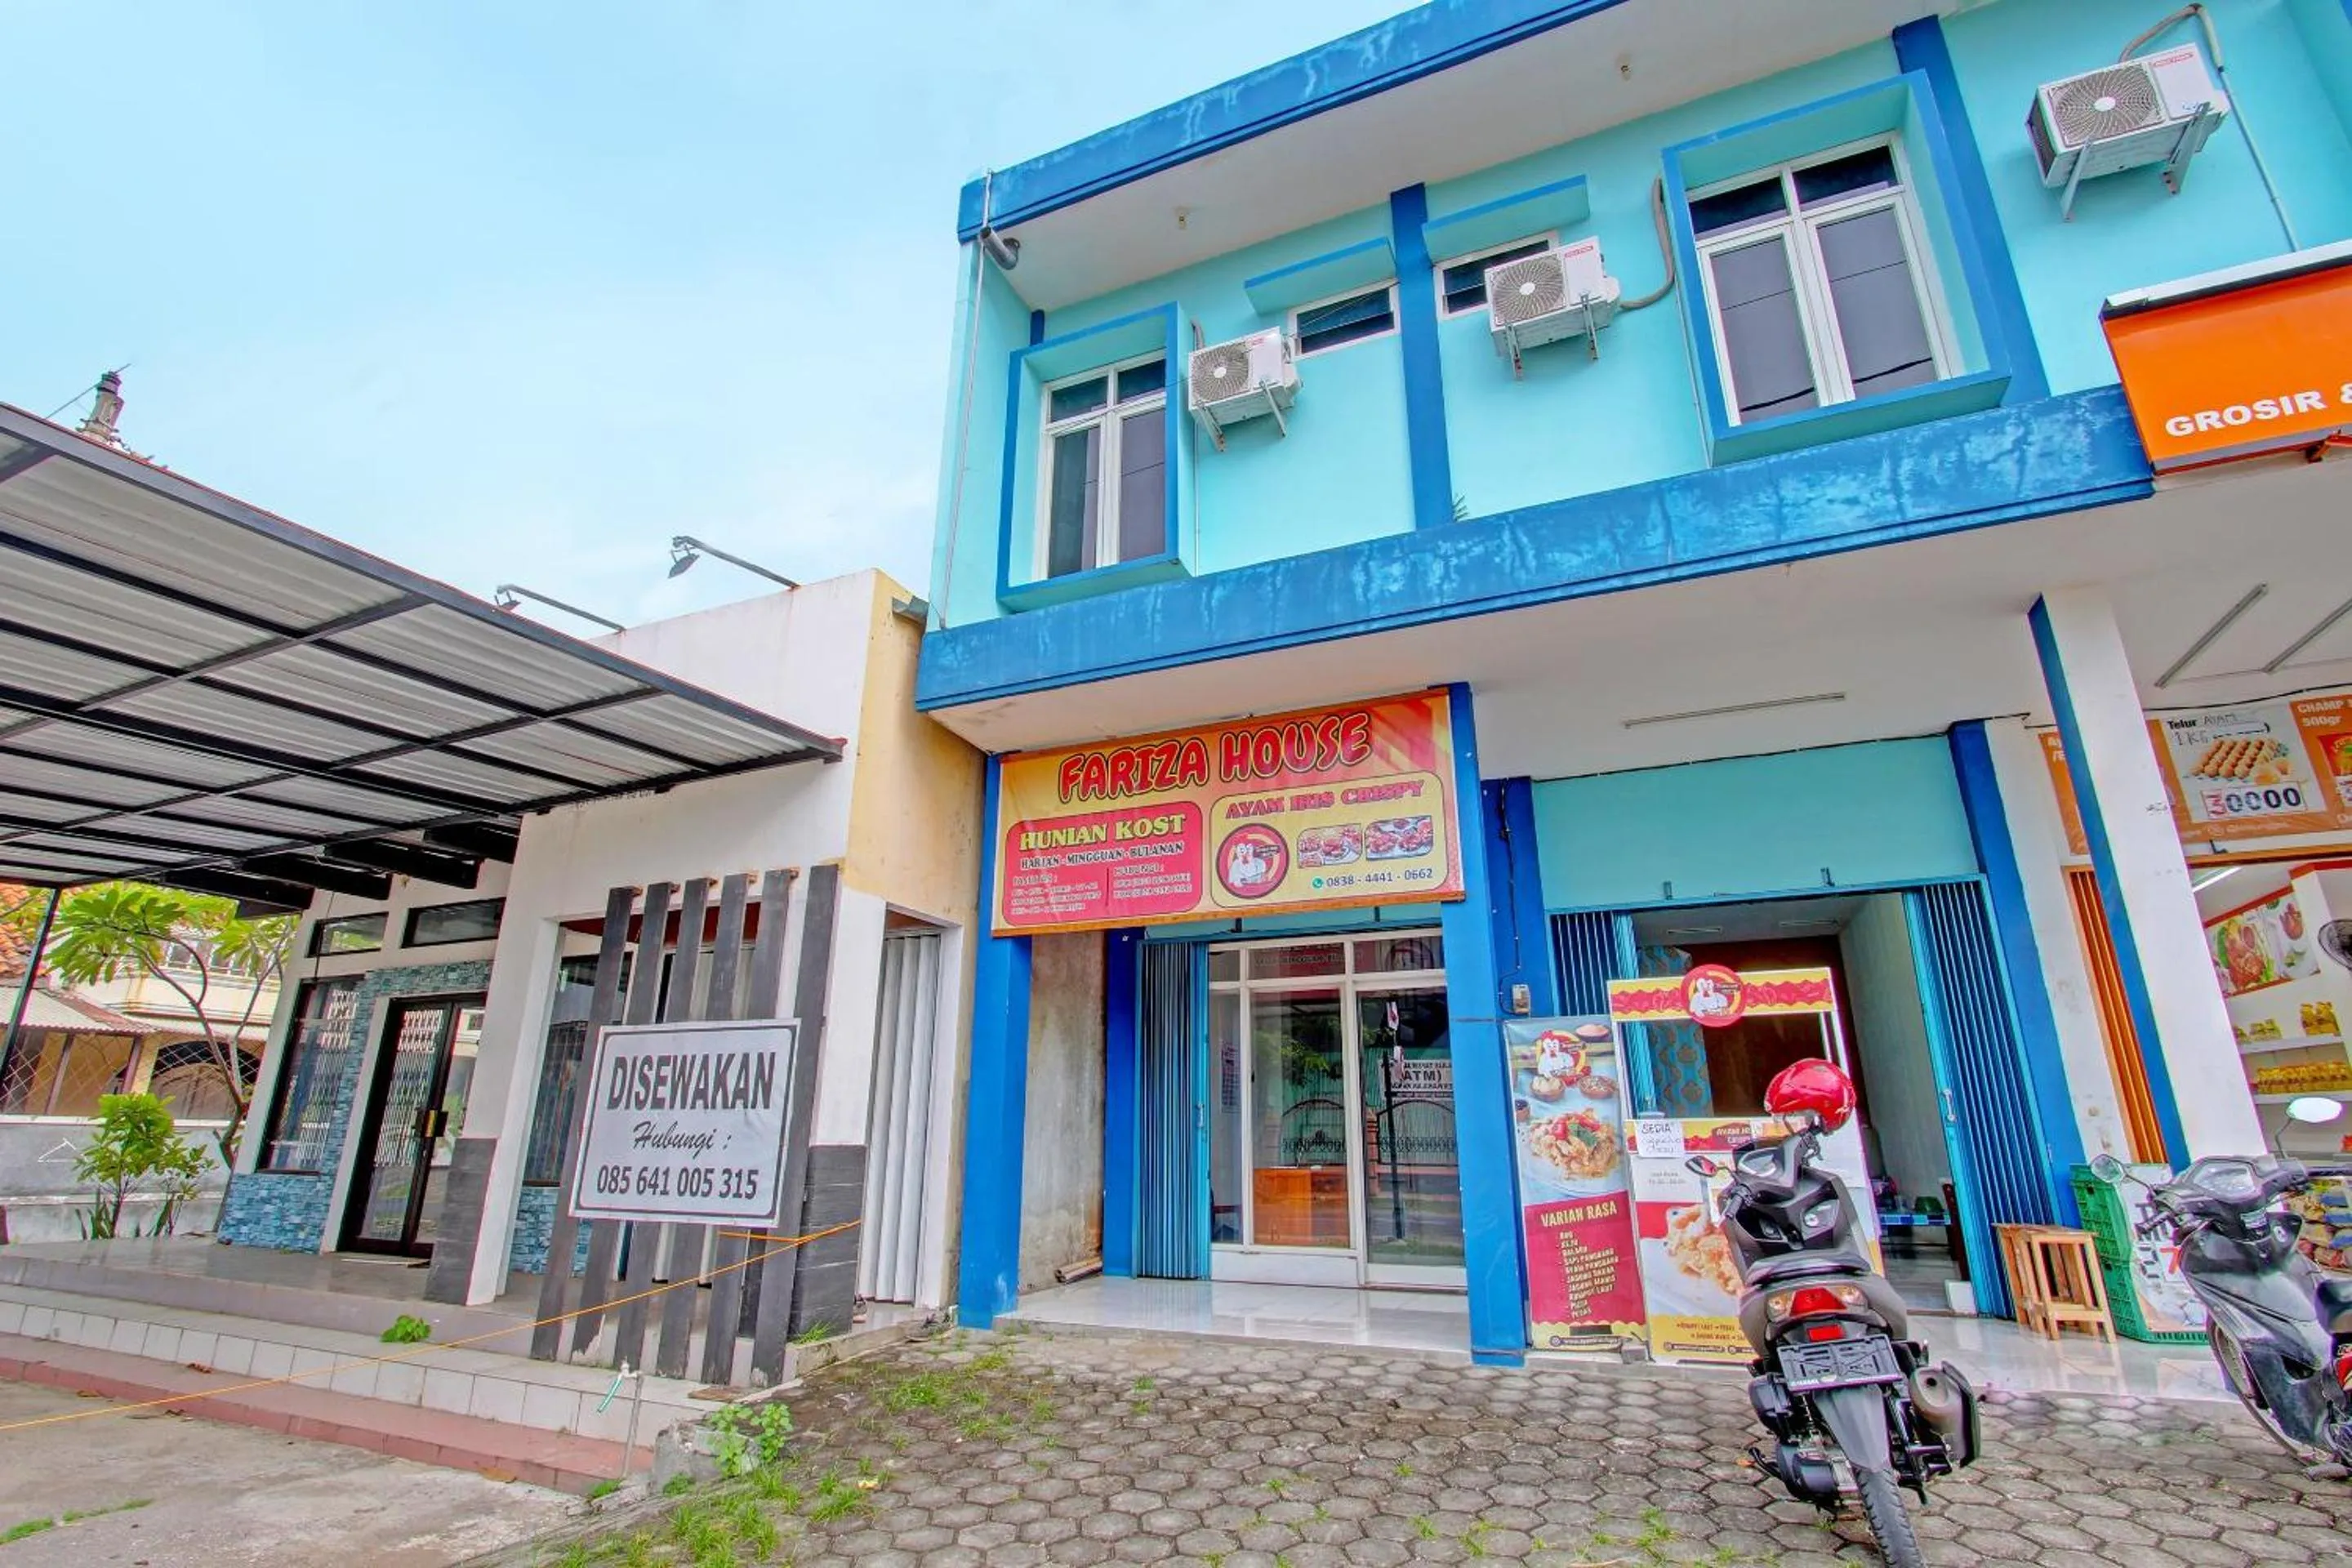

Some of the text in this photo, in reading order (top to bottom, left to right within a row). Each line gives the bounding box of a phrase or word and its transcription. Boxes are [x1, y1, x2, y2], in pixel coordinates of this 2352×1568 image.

[2165, 390, 2326, 436] GROSIR
[2167, 719, 2198, 730] Telur
[1058, 710, 1374, 804] FARIZA HOUSE
[1226, 795, 1285, 819] AYAM
[1019, 813, 1187, 851] HUNIAN KOST
[1022, 856, 1060, 870] HARIAN
[1066, 849, 1124, 866] MINGGUAN
[1129, 842, 1185, 858] BULANAN
[1327, 872, 1354, 887] 0838
[1365, 871, 1393, 884] 4441
[1404, 868, 1433, 881] 0662
[607, 1052, 776, 1111] DISEWAKAN
[633, 1120, 717, 1160] Hubungi
[597, 1165, 759, 1200] 085 641 005 315
[1541, 1200, 1617, 1227] VARIAN RASA
